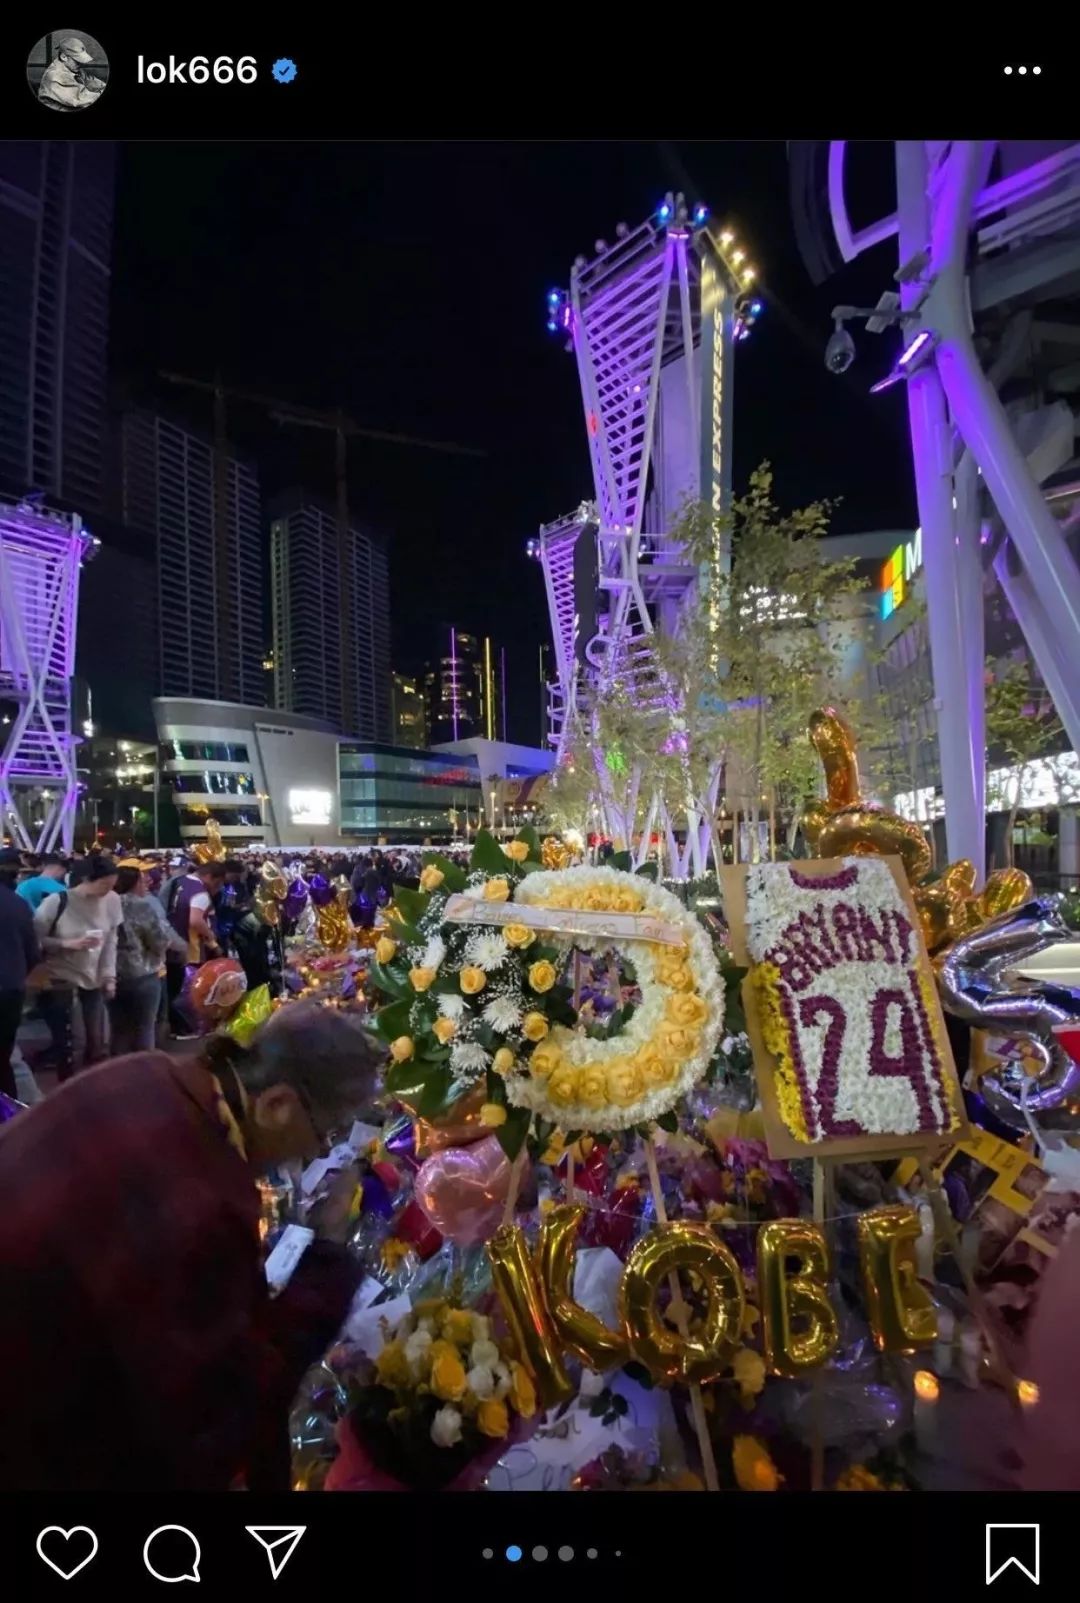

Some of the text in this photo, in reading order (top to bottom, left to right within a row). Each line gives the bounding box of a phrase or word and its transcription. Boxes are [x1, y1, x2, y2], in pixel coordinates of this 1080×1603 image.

[712, 307, 724, 474] EXPRESS
[764, 902, 914, 992] BRYANT
[799, 988, 938, 1136] 24
[487, 1202, 939, 1410] KOBE
